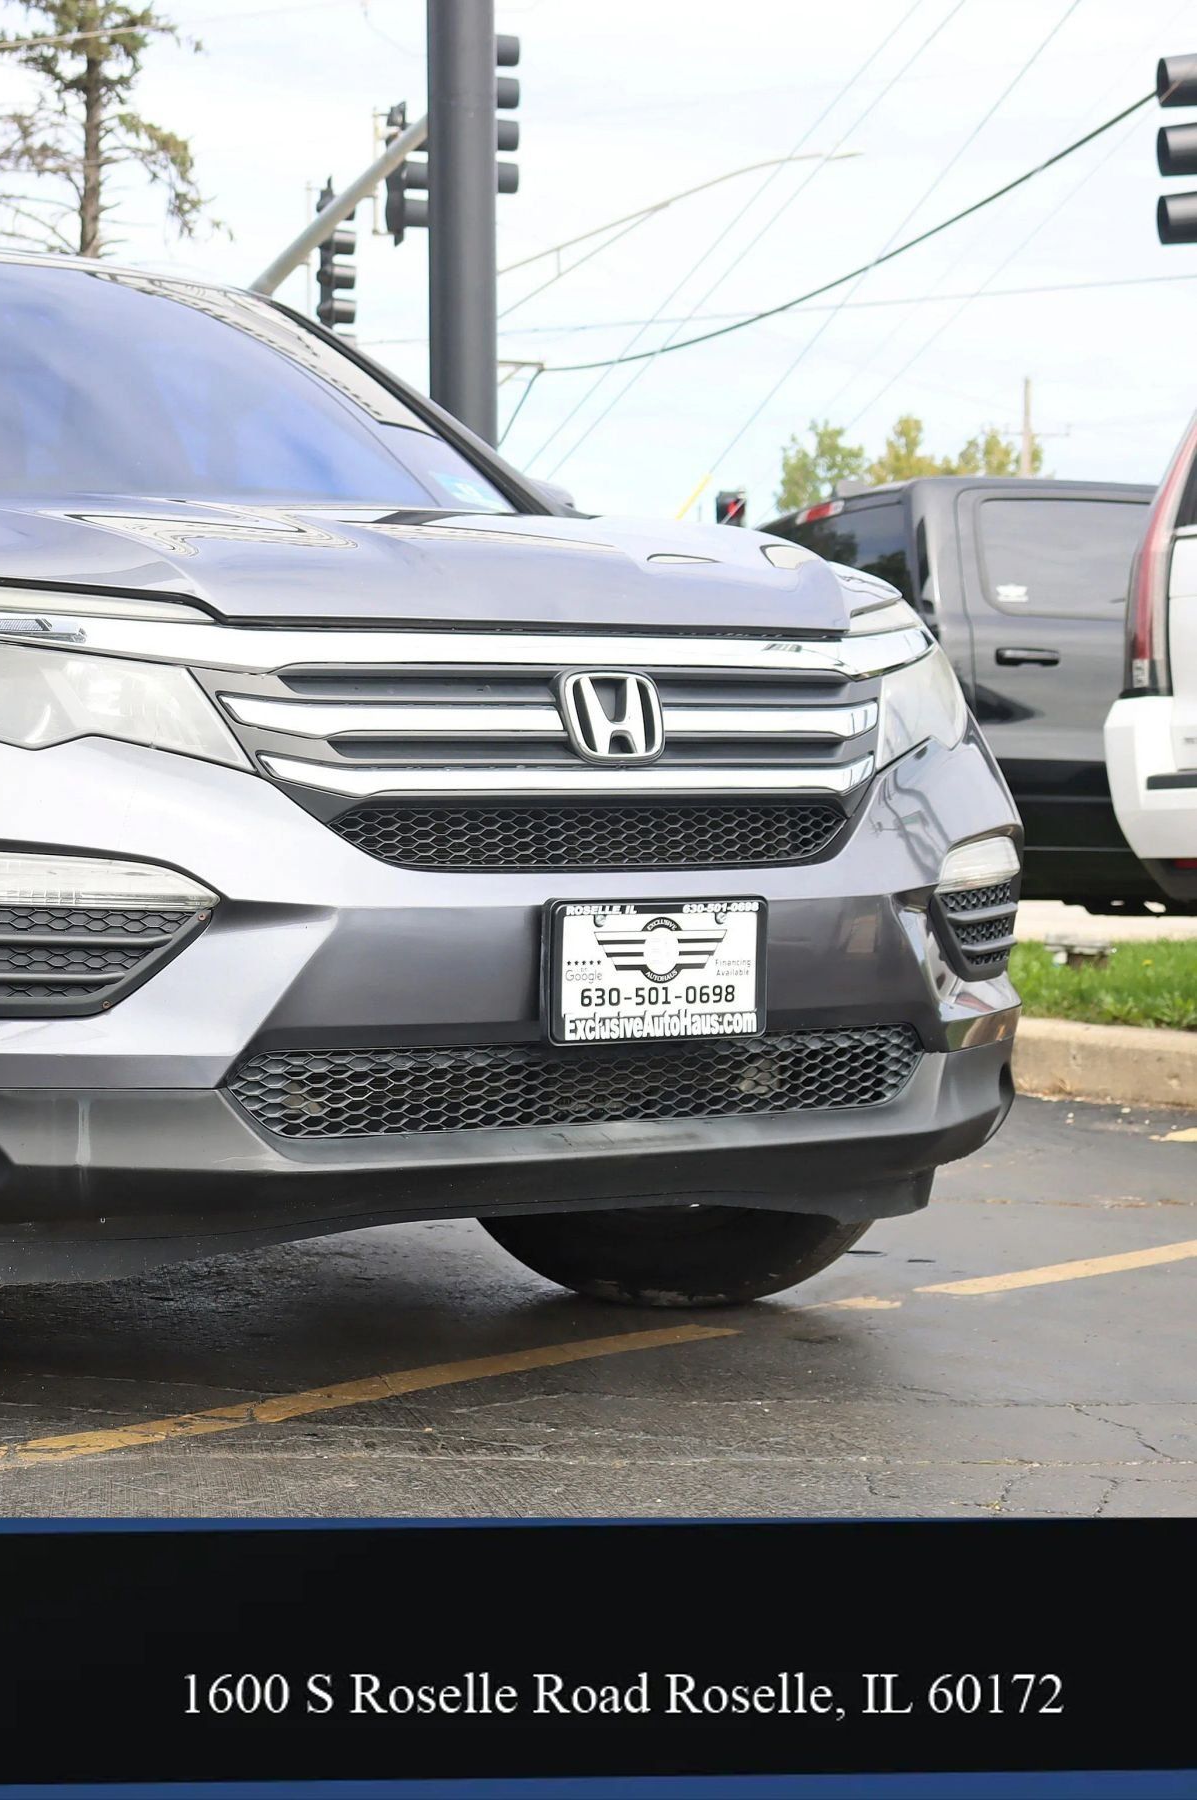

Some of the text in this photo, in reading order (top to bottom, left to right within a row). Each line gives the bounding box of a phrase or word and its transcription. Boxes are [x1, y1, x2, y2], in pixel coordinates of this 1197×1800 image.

[624, 905, 638, 915] IL
[682, 902, 760, 914] 630-501-0698
[715, 959, 752, 968] Financing
[565, 969, 603, 984] Google
[645, 969, 678, 984] AUTOHAUS
[716, 969, 750, 977] Available
[580, 984, 736, 1008] 630-501-0698
[564, 1010, 758, 1041] ExclusiveAutoHaus.com
